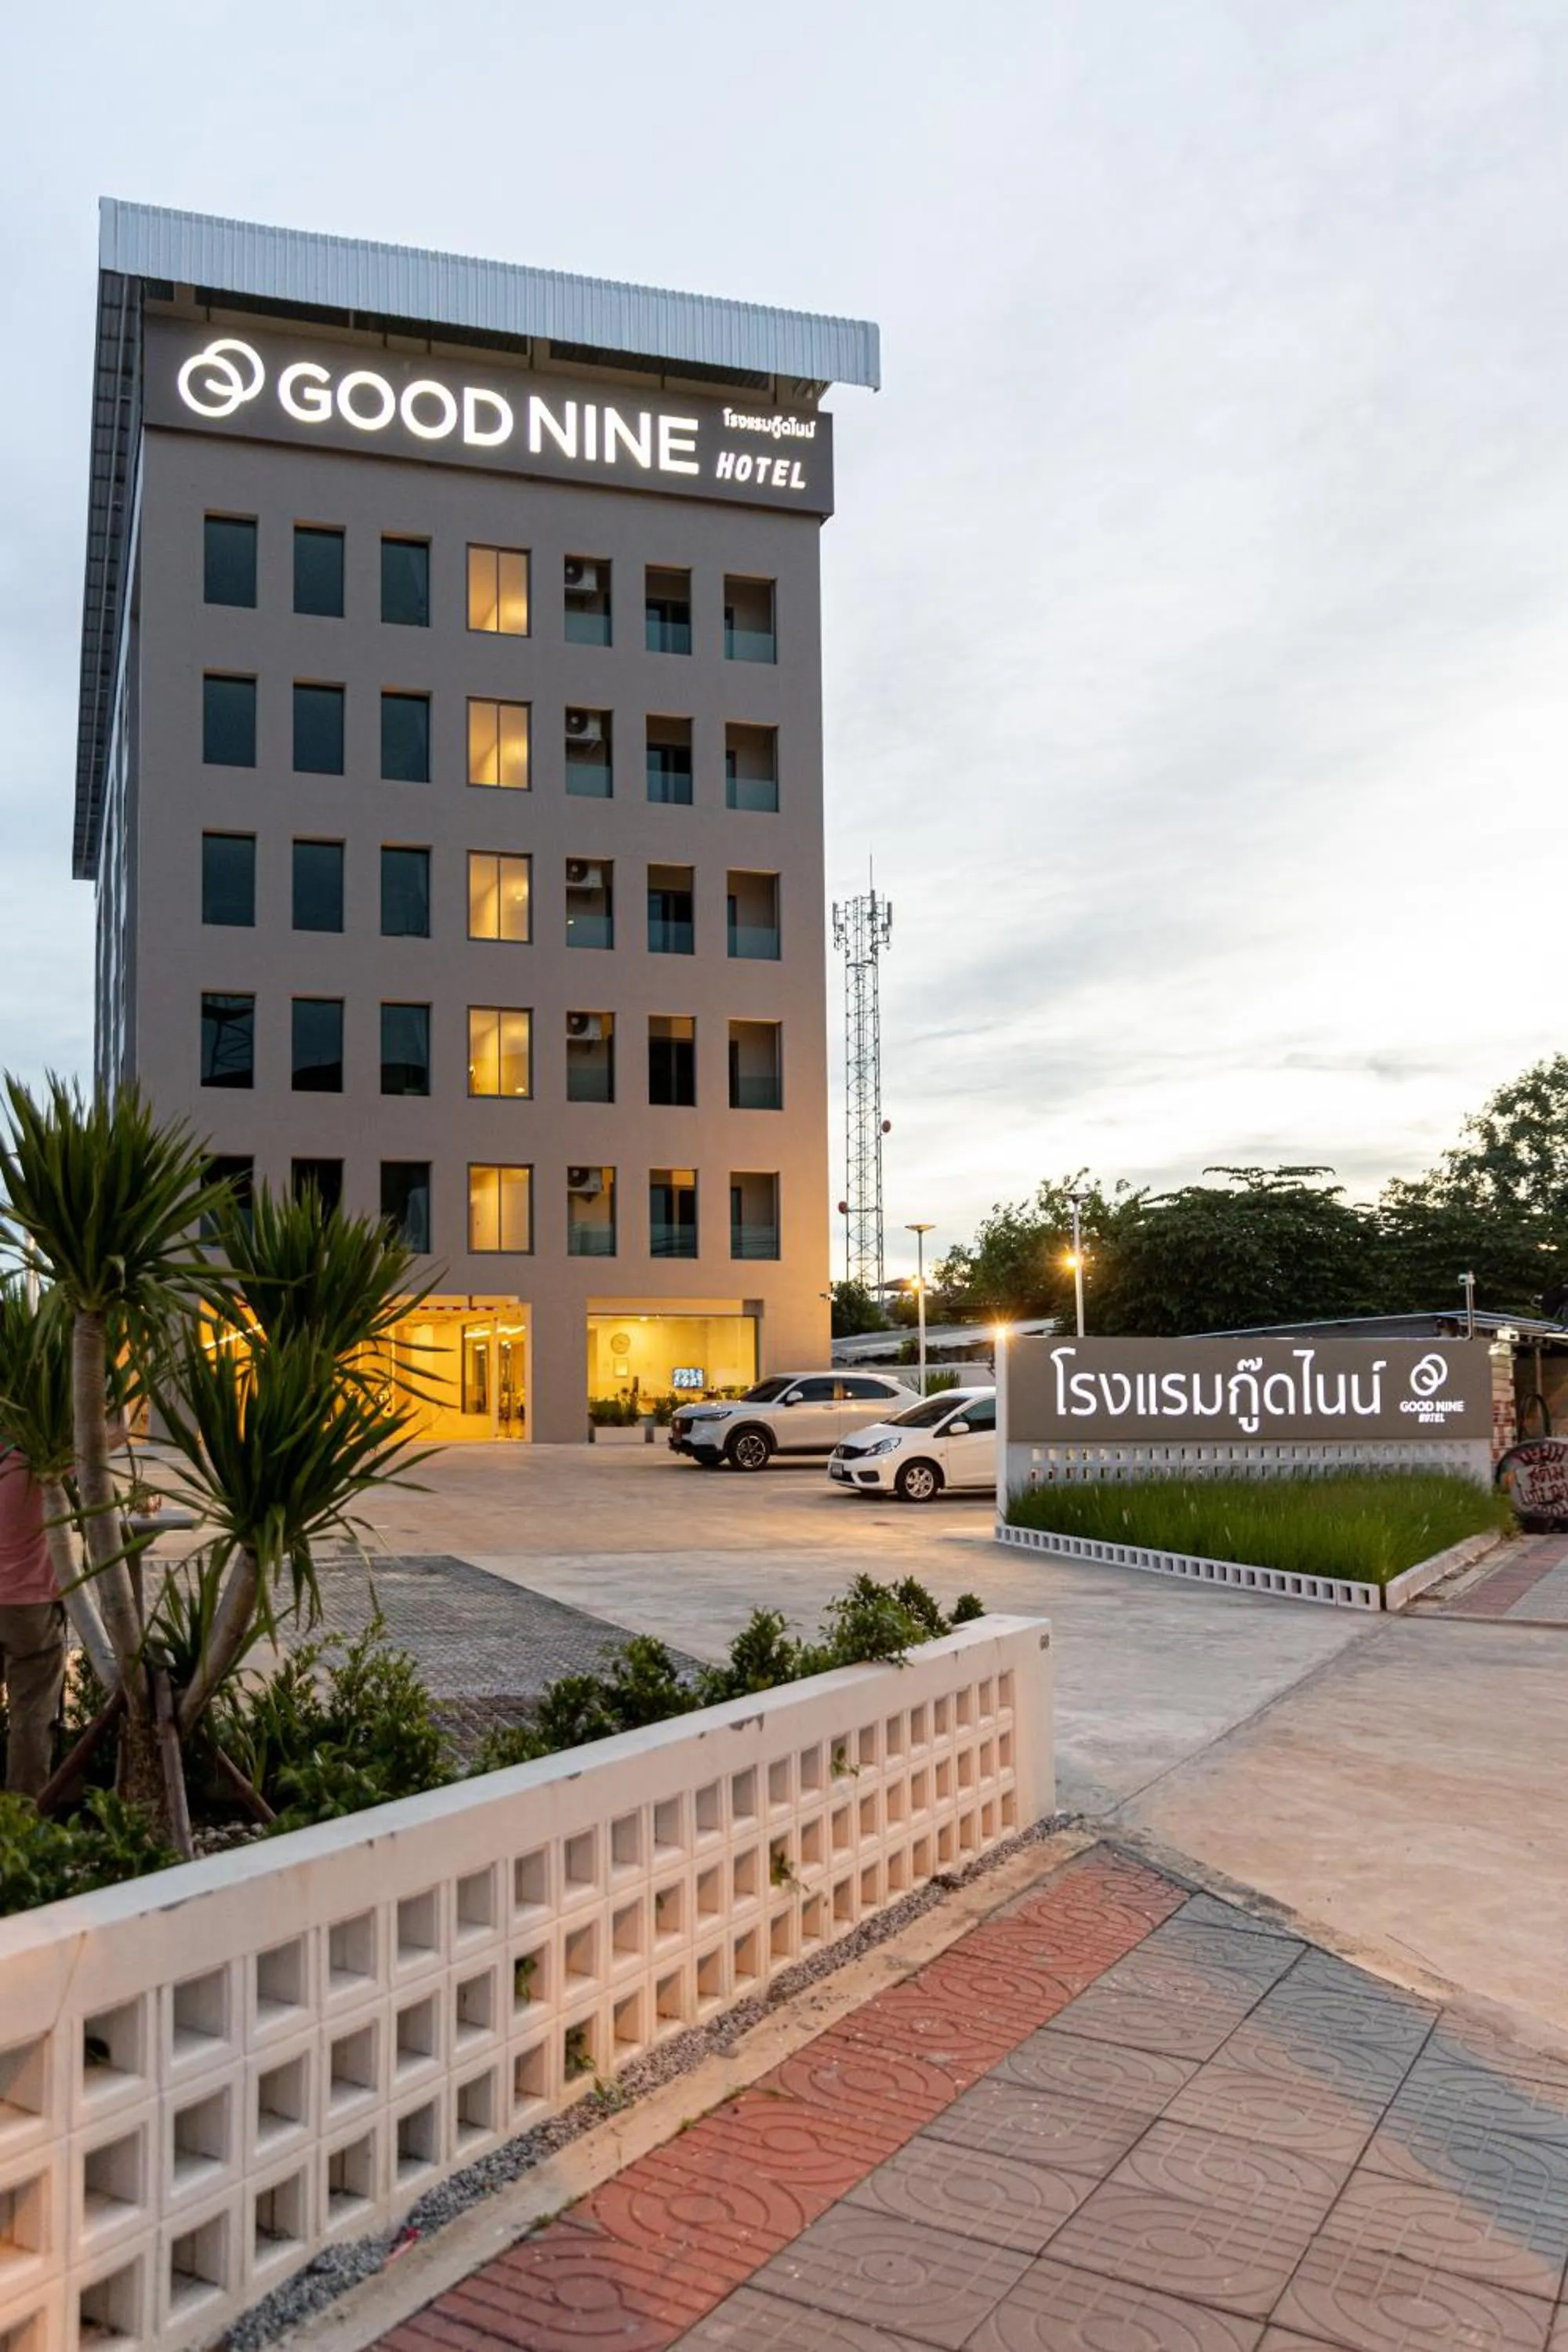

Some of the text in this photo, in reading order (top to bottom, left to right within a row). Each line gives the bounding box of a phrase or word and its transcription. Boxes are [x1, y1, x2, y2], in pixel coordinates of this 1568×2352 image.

[278, 361, 700, 475] GOOD NINE
[716, 451, 806, 489] HOTEL
[1050, 1346, 1387, 1433] โรงแรมกู๊ดไนน์
[1399, 1400, 1465, 1413] GOOD NINE
